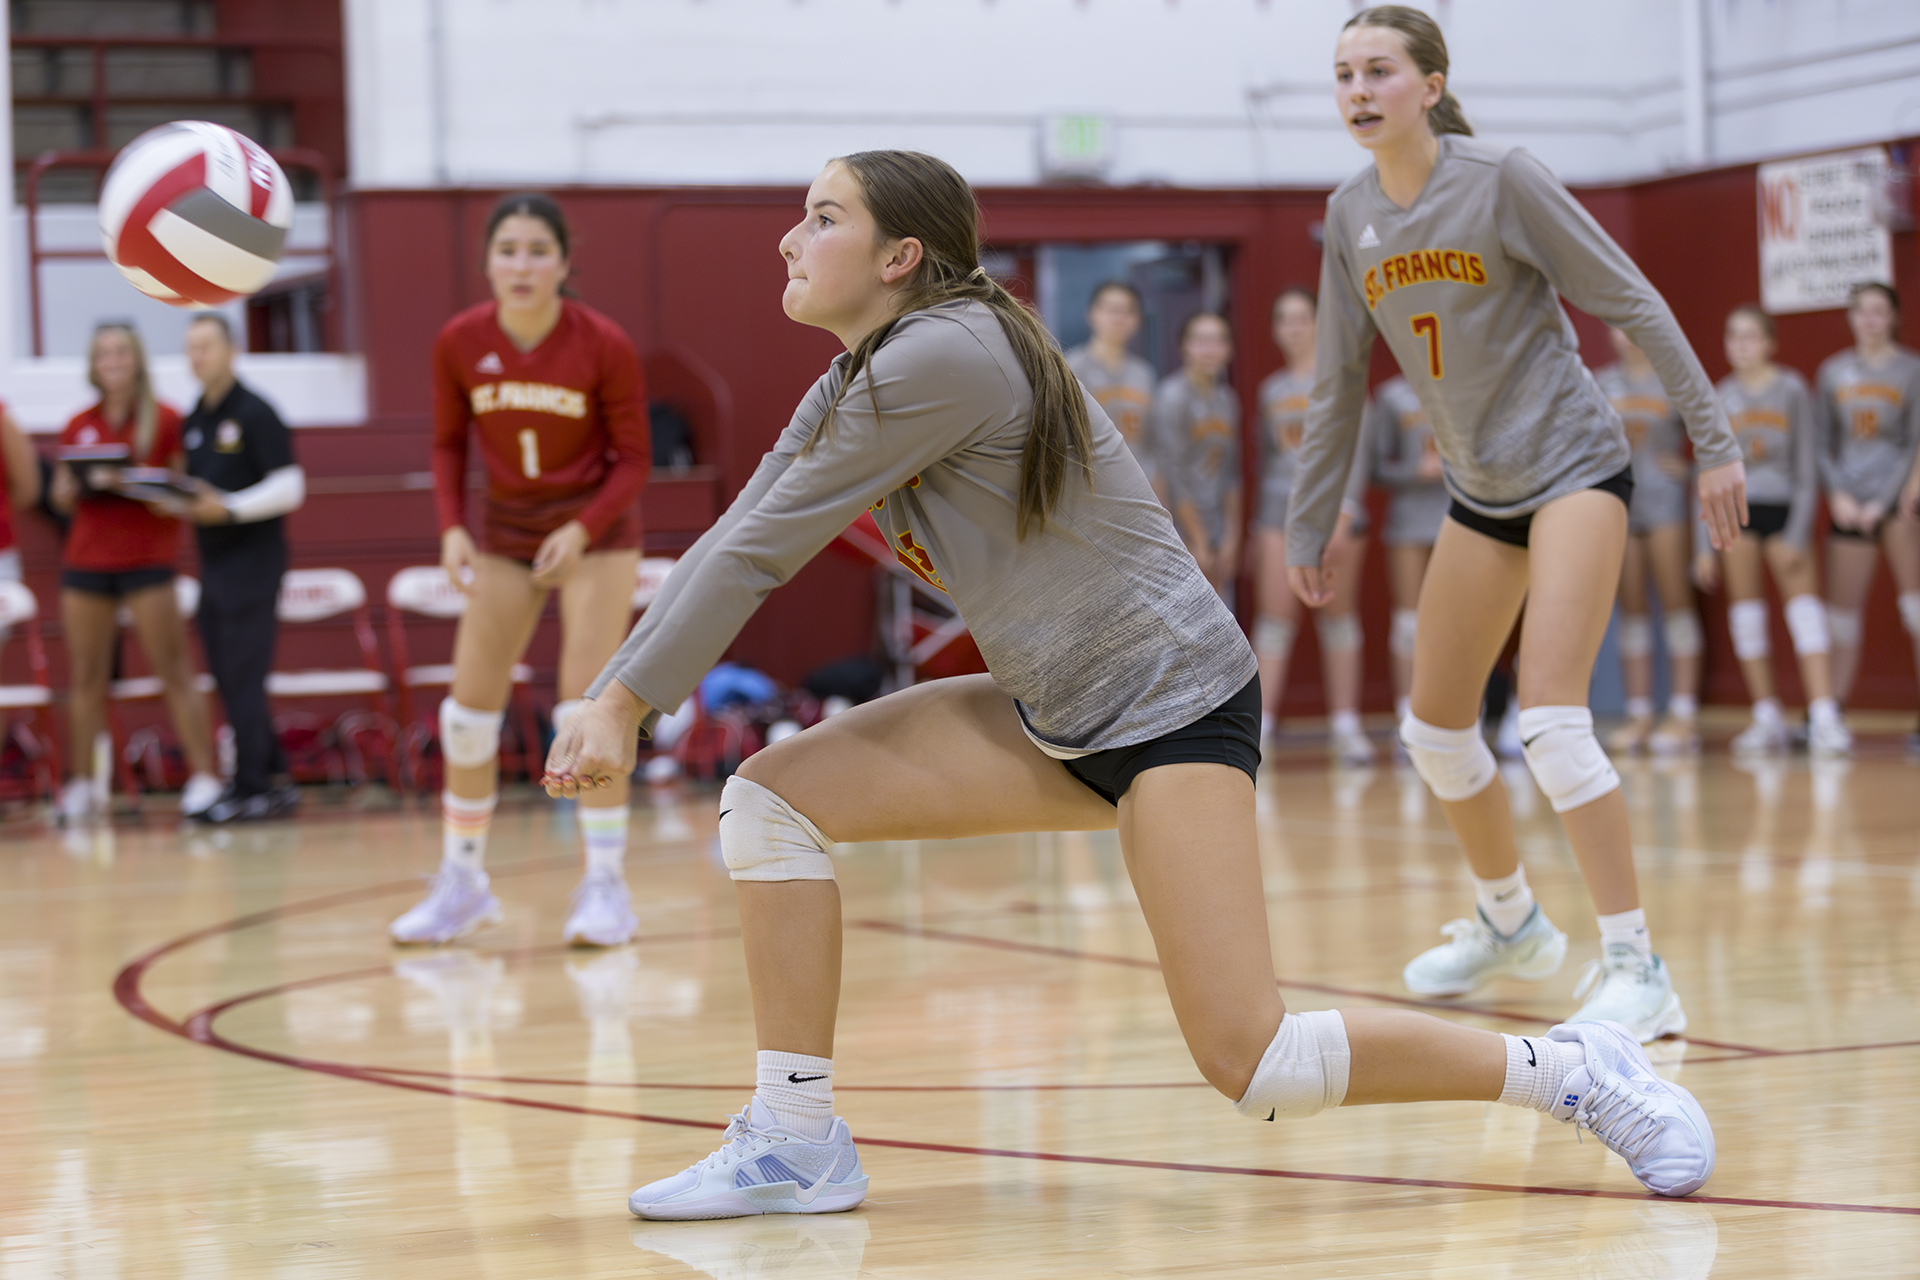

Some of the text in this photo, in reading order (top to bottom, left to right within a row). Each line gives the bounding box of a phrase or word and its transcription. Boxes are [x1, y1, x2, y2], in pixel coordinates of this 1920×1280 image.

[1380, 249, 1489, 292] FRANCIS
[1409, 311, 1444, 381] 7
[518, 428, 541, 479] 1
